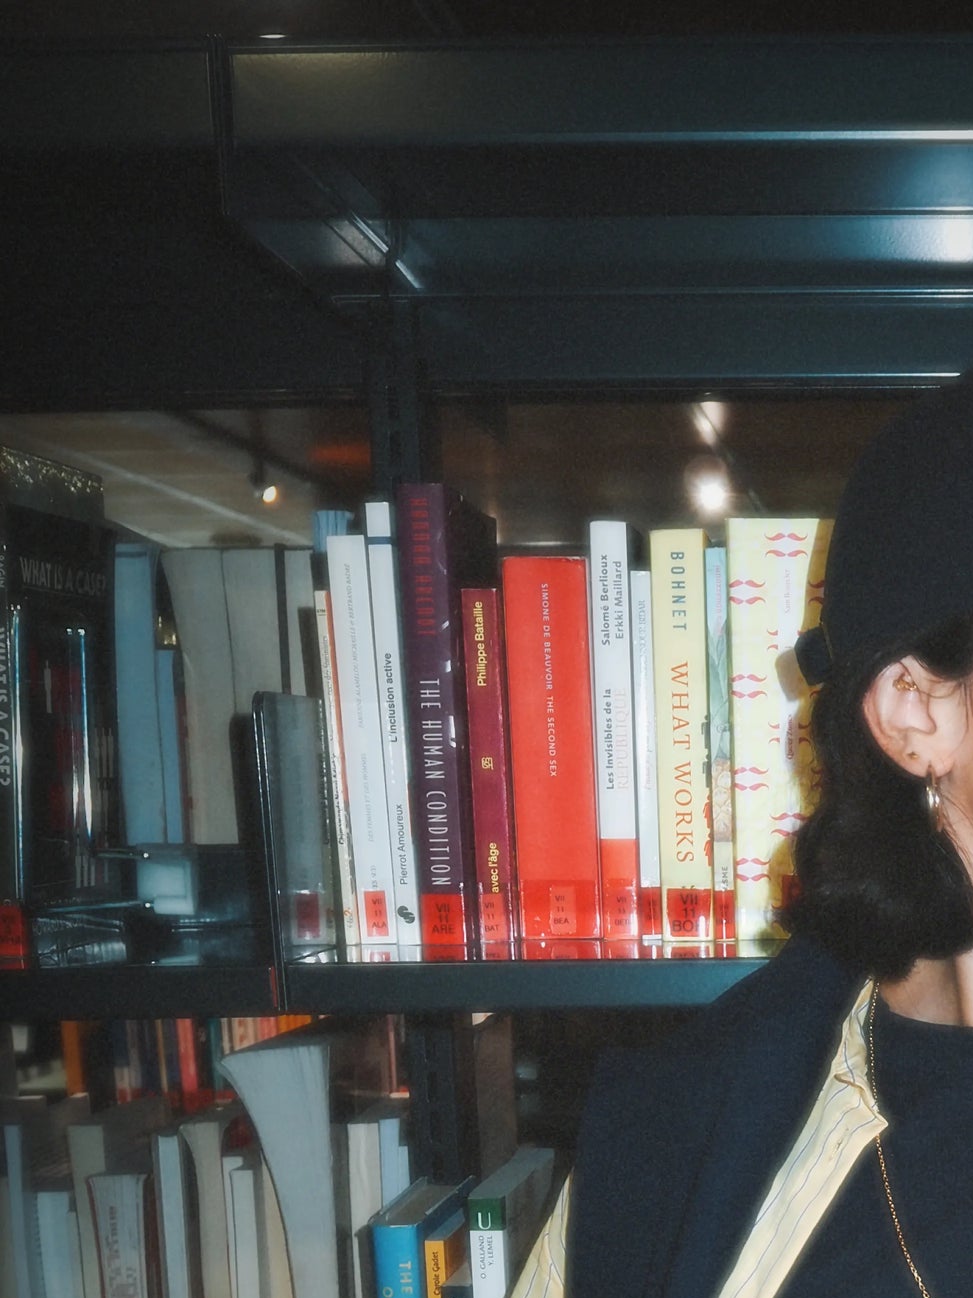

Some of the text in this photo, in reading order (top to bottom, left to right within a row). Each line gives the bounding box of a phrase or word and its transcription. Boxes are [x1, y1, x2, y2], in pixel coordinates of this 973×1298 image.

[19, 556, 51, 587] WHAT
[54, 565, 63, 589] IS
[65, 568, 73, 591] A
[599, 554, 610, 646] Salomé Berlioux
[612, 561, 624, 639] Erkki Maillard
[670, 551, 688, 630] BOHNET
[473, 601, 488, 687] Philippe Bataille
[383, 652, 399, 743] L'inclusion active
[541, 583, 557, 777] SIMONE DE BEAUVOIR THE SECOND SEX
[671, 661, 690, 750] WHAT
[602, 688, 615, 790] Les Invisibles de la
[420, 678, 452, 885] THE HUMAN CONDITION
[673, 760, 694, 863] WORKS
[395, 804, 408, 885] Pierrot Amoureux
[487, 842, 500, 893] avec l'âge
[431, 924, 456, 934] ARE
[436, 903, 450, 912] VII
[672, 921, 700, 932] BO
[680, 894, 698, 905] VII
[682, 908, 696, 918] 11
[477, 1212, 491, 1230] U
[478, 1235, 486, 1270] GALLAND
[398, 1260, 414, 1294] THE
[431, 1251, 441, 1296] Carole Gadet
